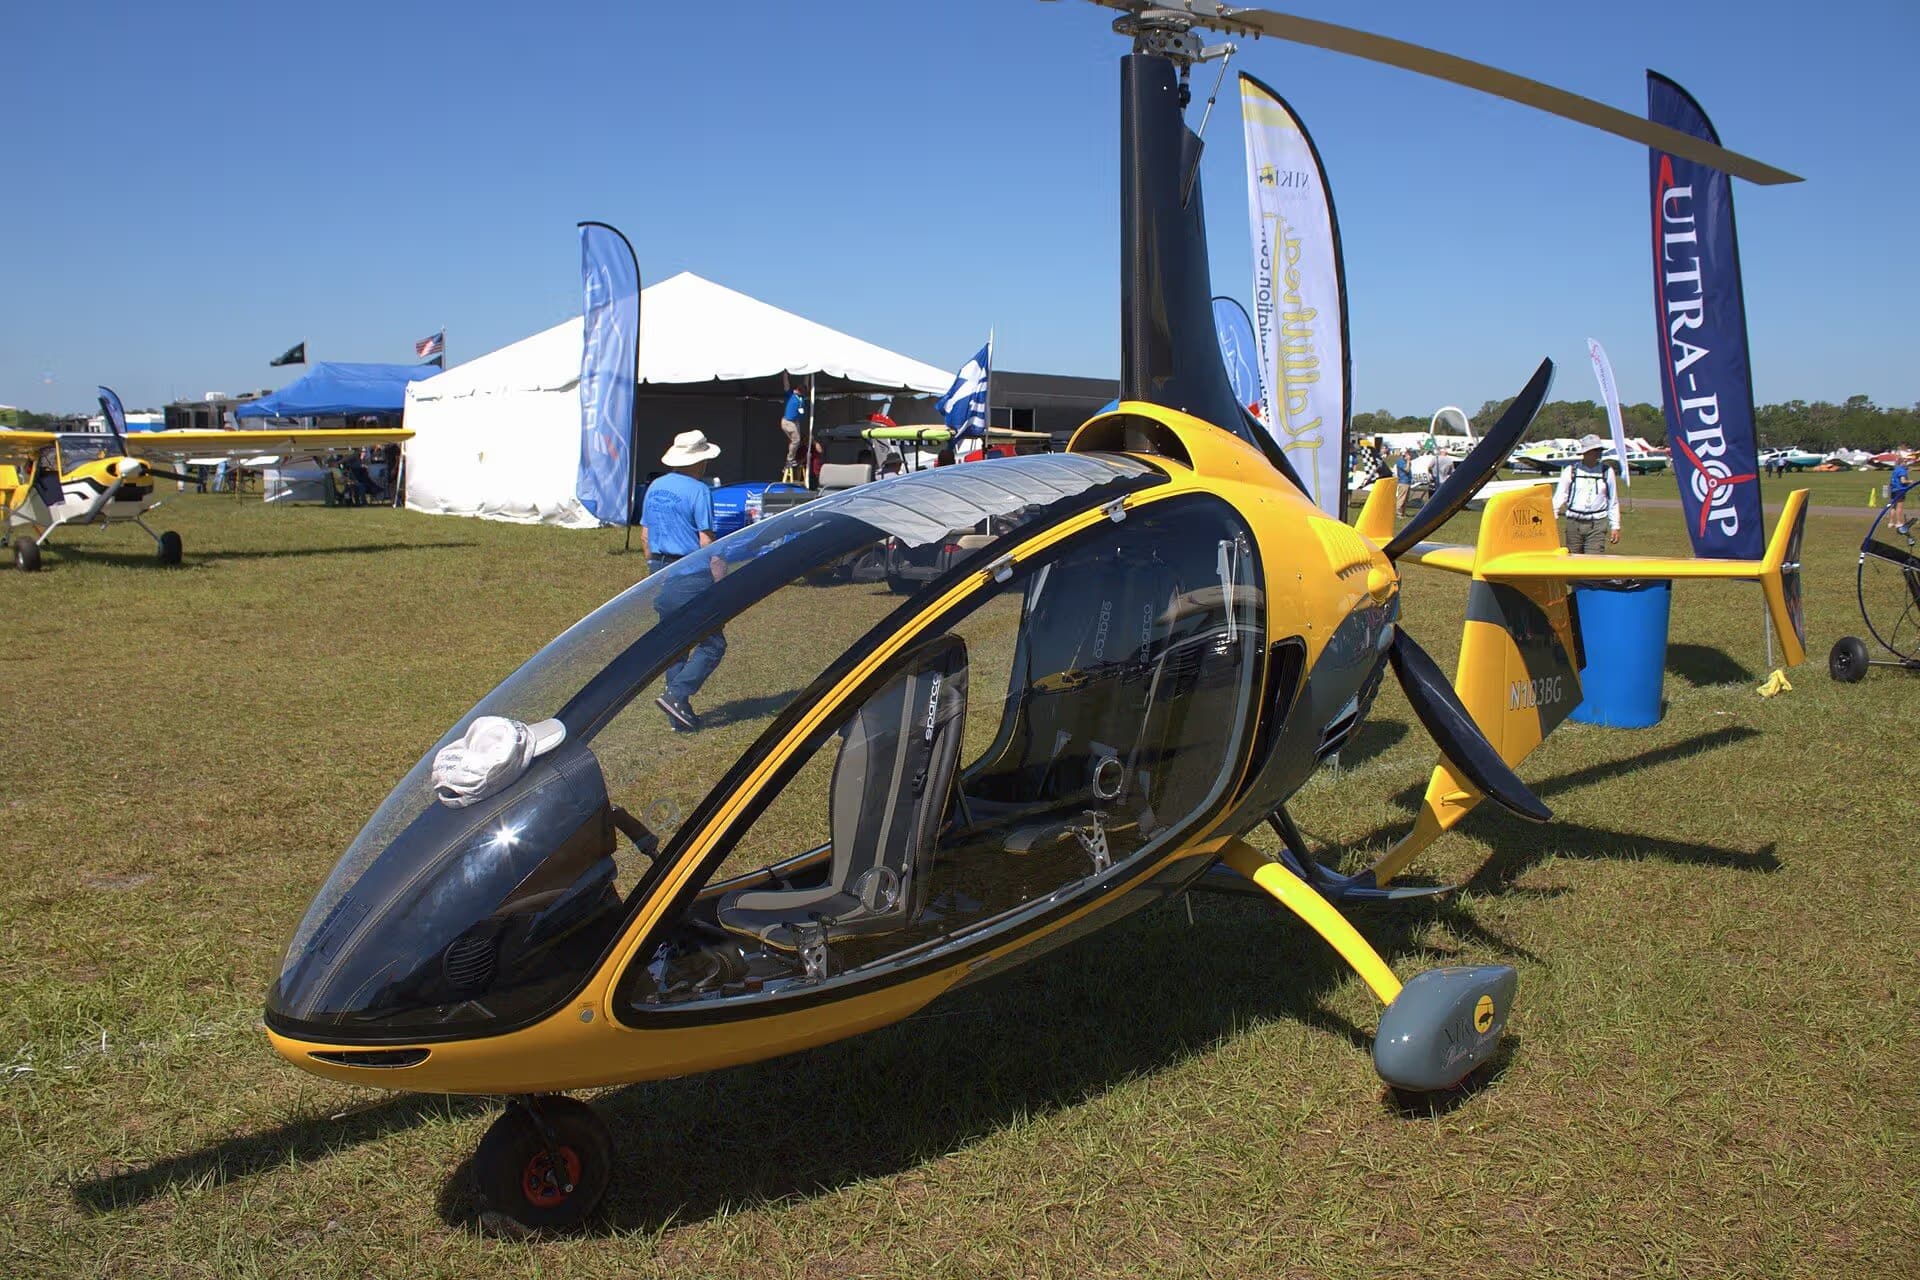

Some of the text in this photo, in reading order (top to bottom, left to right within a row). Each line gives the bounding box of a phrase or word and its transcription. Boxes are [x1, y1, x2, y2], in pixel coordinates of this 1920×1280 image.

[1662, 185, 1739, 537] ULTRA-PROP
[925, 672, 942, 741] sparco
[1509, 675, 1562, 711] N103BG
